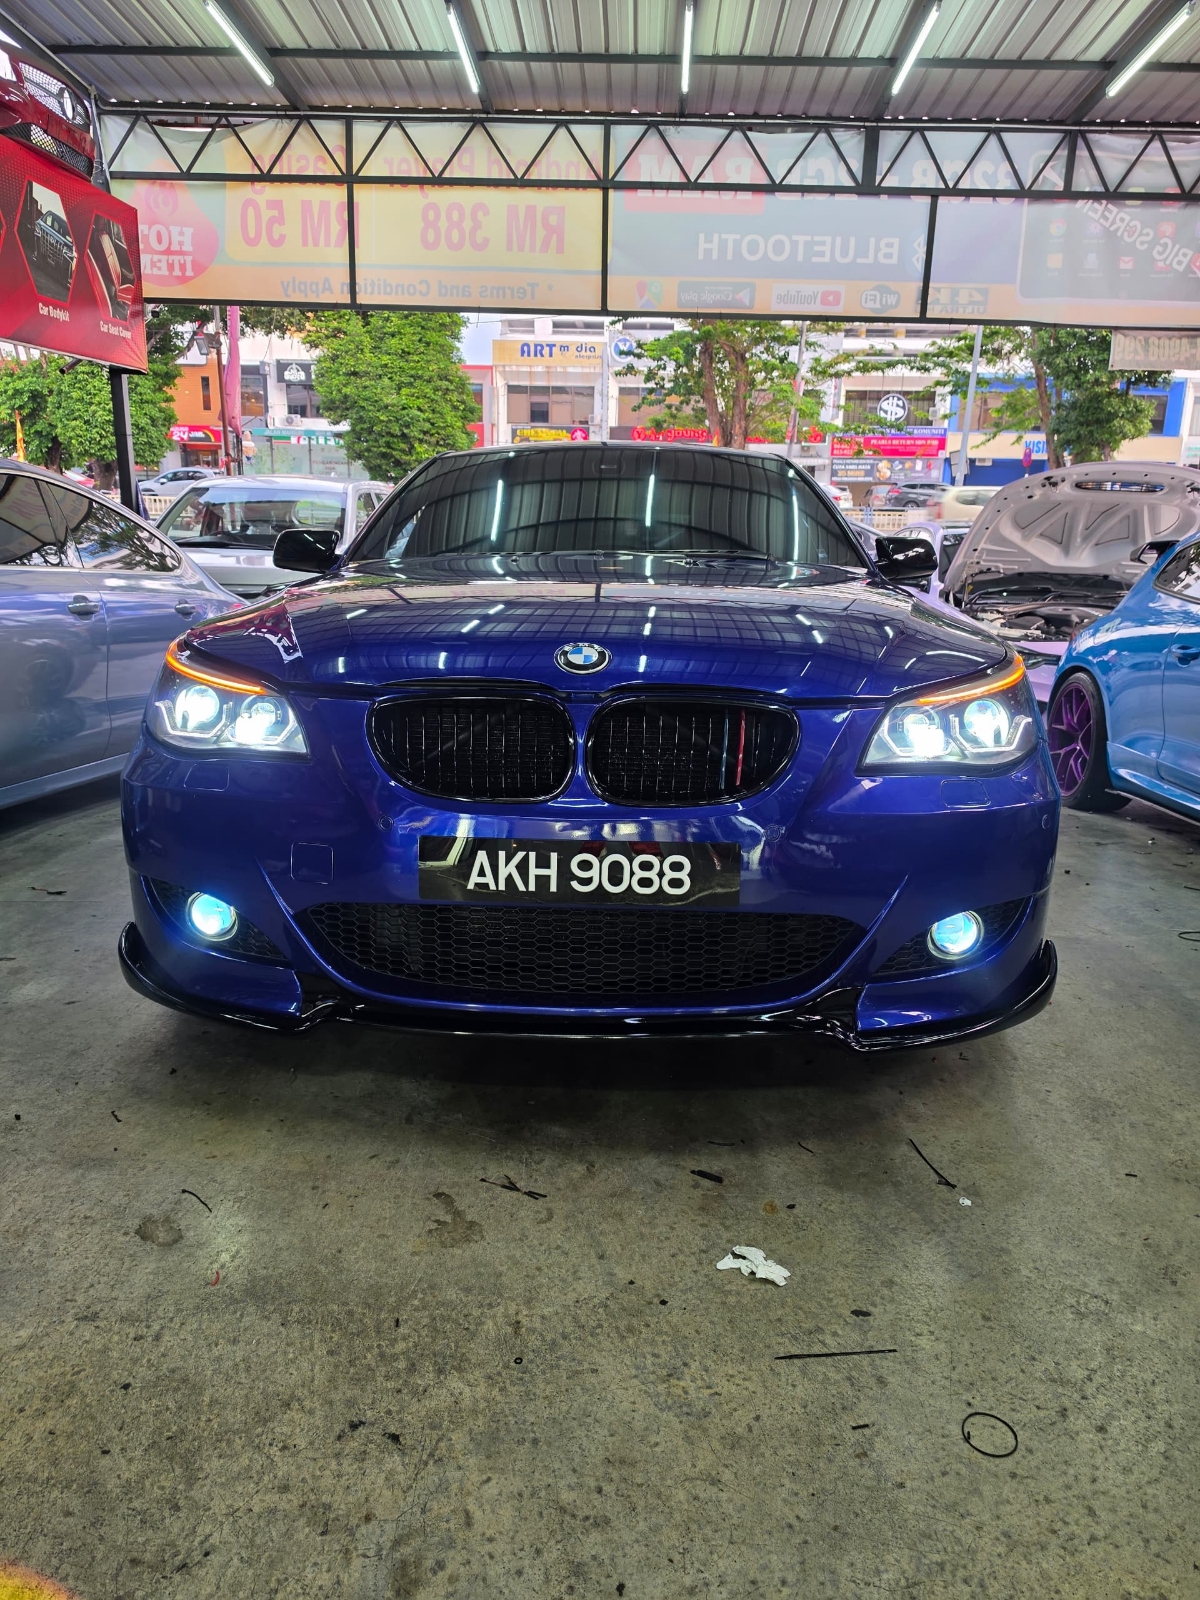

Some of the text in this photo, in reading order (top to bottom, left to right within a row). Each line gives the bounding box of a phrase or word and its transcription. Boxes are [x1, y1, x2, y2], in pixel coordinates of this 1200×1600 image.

[38, 302, 70, 322] Car Bodykit
[100, 320, 109, 333] Car
[119, 326, 132, 340] Cover
[520, 342, 556, 358] ART
[172, 431, 188, 441] 24
[466, 850, 692, 895] AKH 9088
